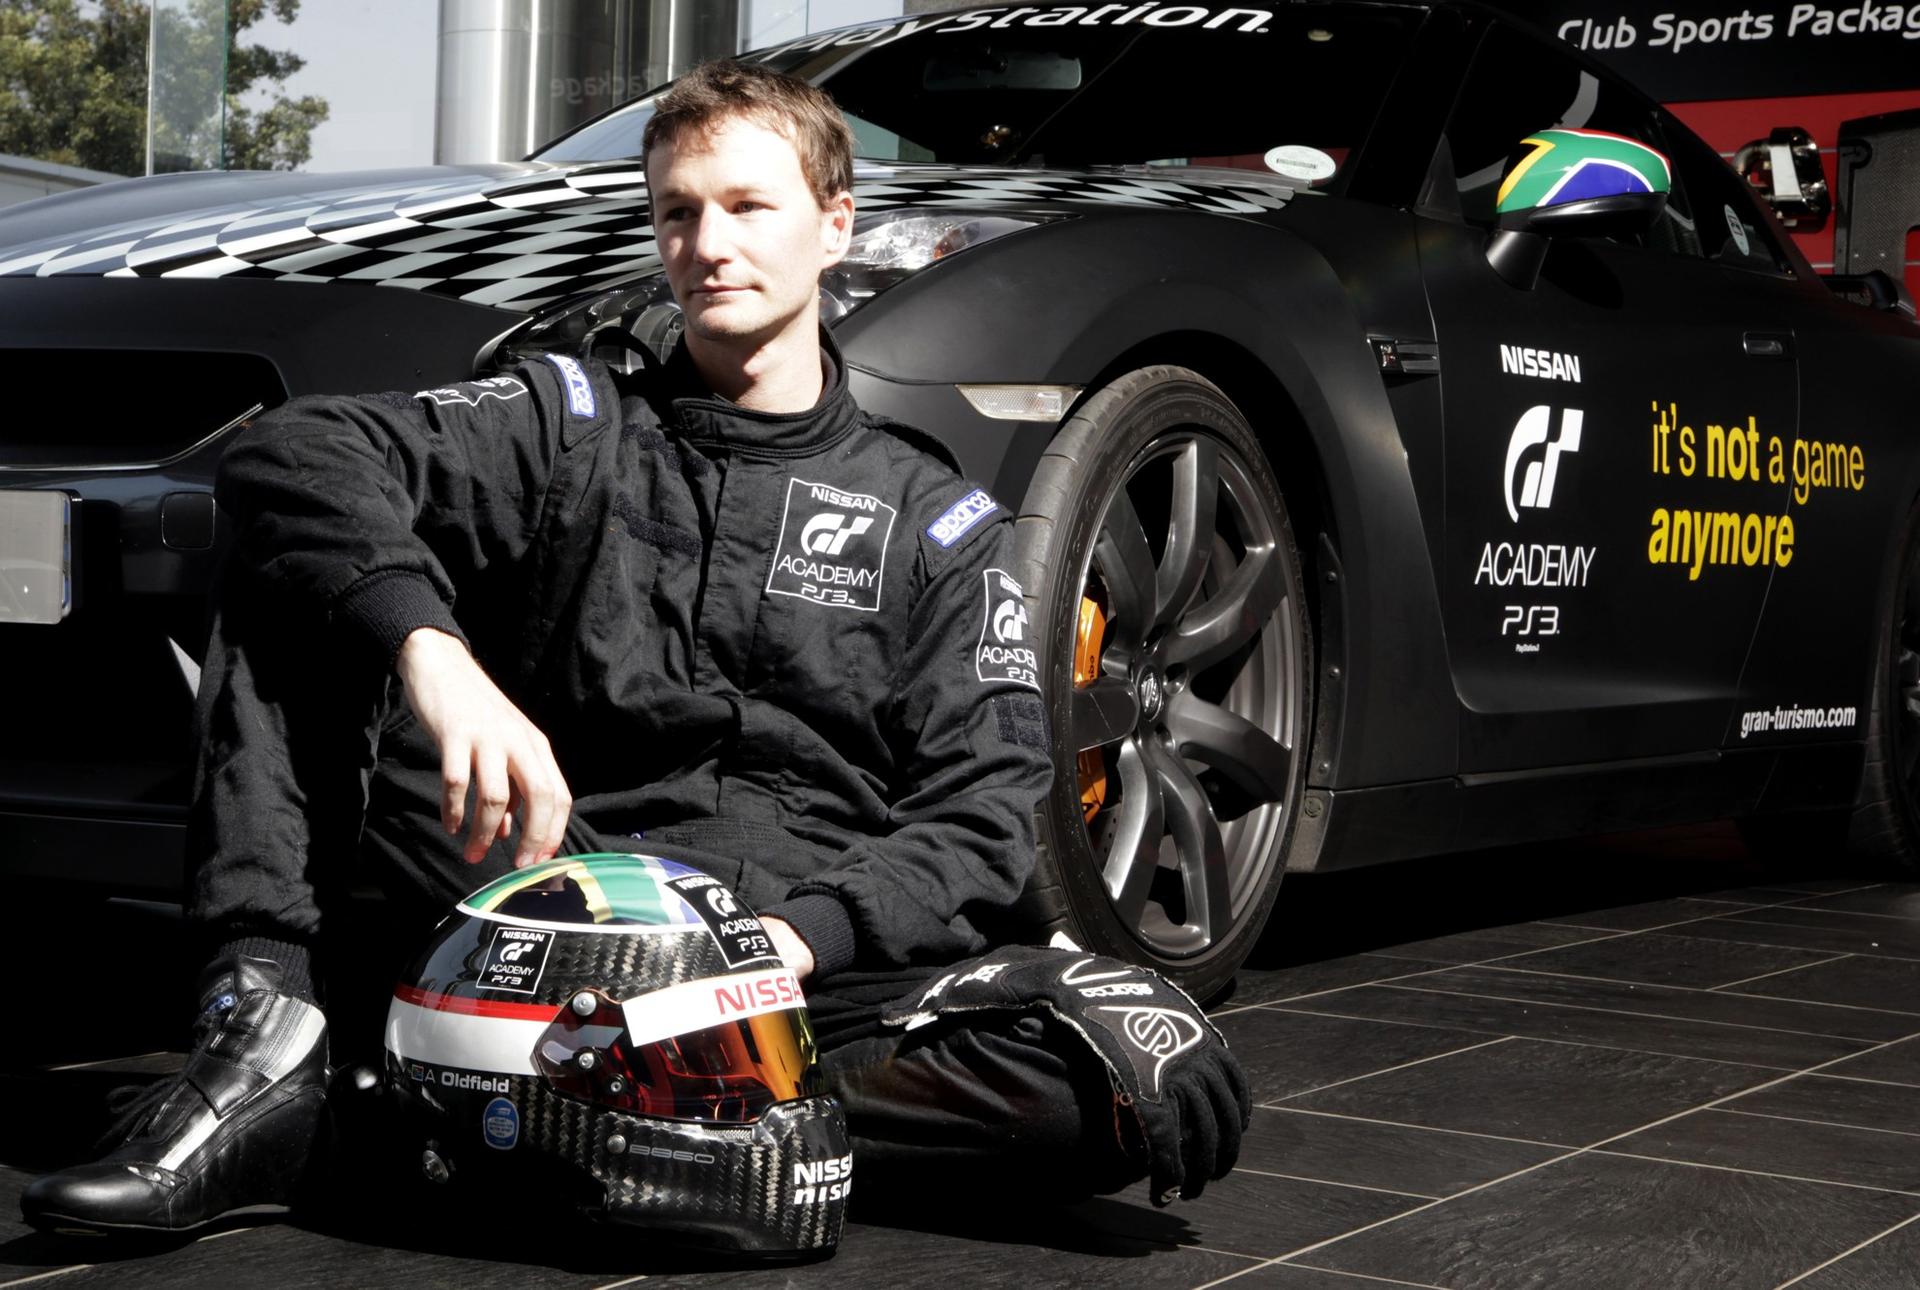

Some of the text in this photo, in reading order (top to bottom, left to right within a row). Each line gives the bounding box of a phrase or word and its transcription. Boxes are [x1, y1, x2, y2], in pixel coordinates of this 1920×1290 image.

[1557, 15, 1637, 50] Club
[1648, 7, 1774, 53] Sports
[1500, 344, 1581, 383] NISSAN
[1652, 401, 1865, 505] it's not a game
[811, 486, 877, 512] NISSAN
[1648, 508, 1795, 581] anymore
[777, 554, 879, 588] ACADEMY
[1474, 542, 1596, 587] ACADEMY
[801, 582, 849, 602] PS3
[1502, 606, 1559, 635] PS3
[1740, 703, 1857, 738] gran-turismo.com
[502, 930, 545, 942] NISSAN
[737, 935, 769, 952] PS3
[488, 964, 535, 976] ACADEMY
[491, 974, 522, 985] PS3
[441, 1071, 510, 1093] Oldfield
[794, 1150, 853, 1185] NISS
